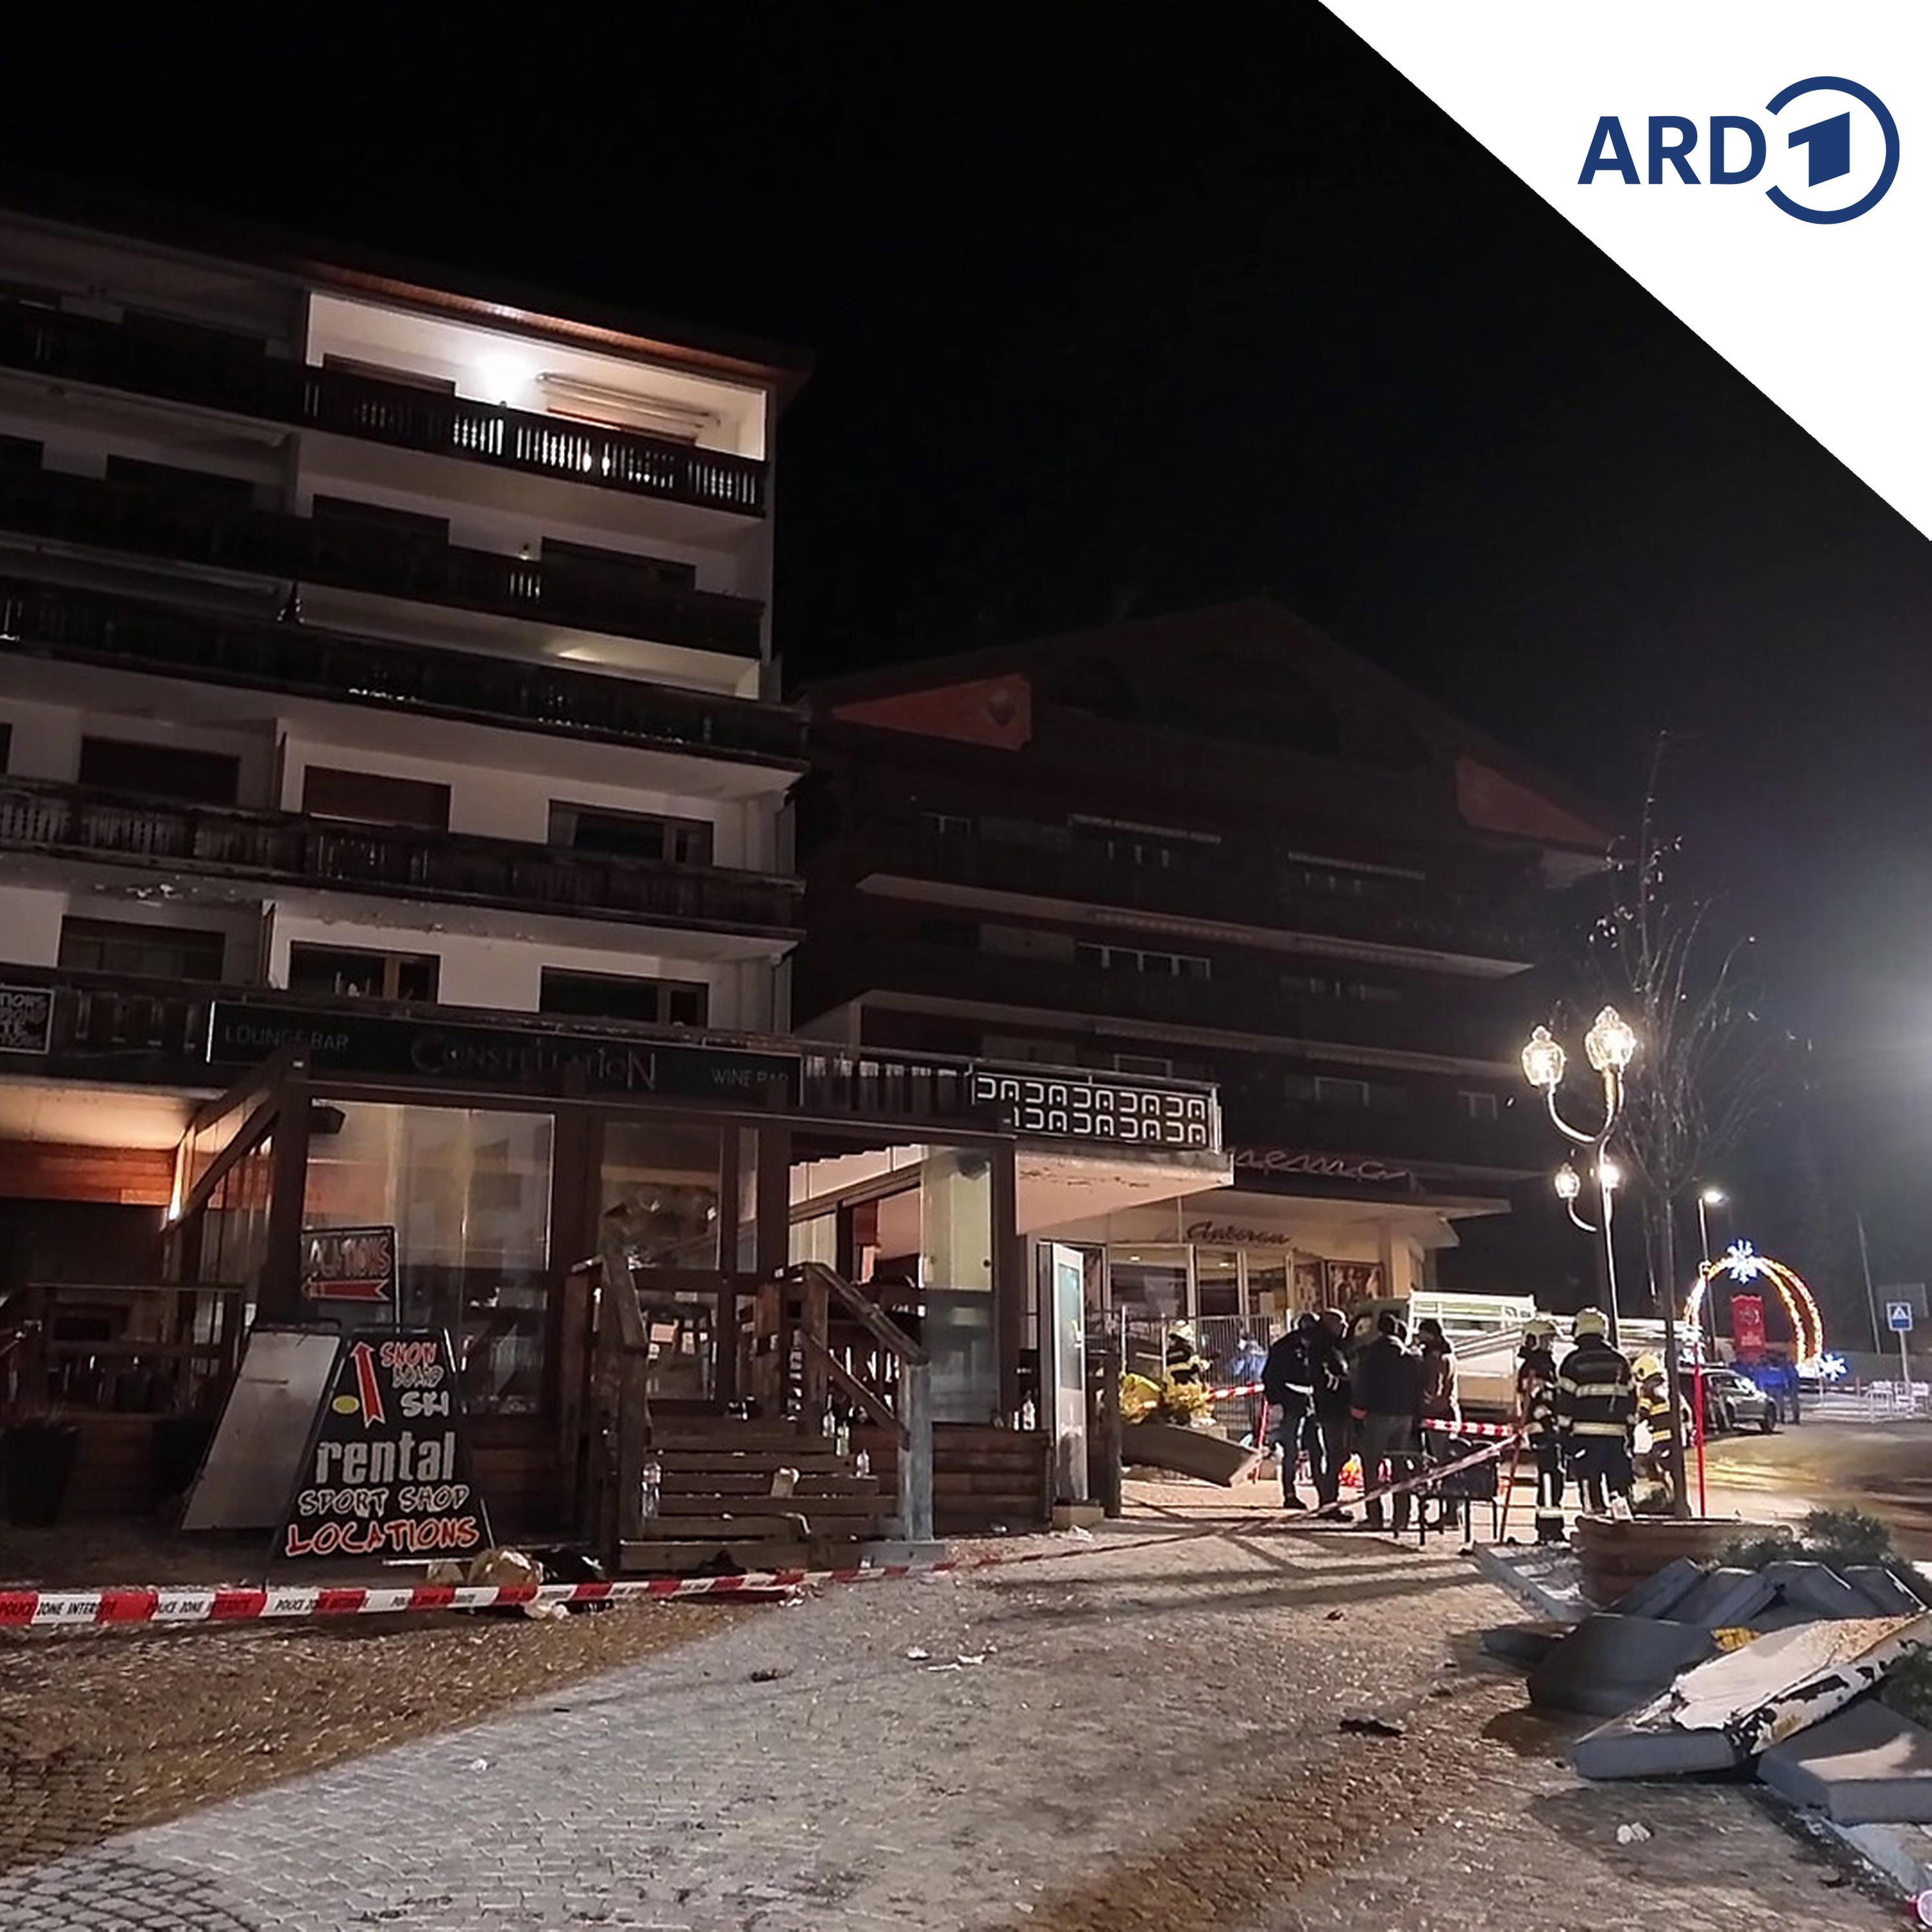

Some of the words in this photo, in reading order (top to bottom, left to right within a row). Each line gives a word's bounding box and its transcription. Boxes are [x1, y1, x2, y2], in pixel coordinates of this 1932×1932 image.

[310, 1030, 350, 1052] BAR
[710, 1066, 753, 1087] WINE
[379, 1340, 438, 1368] SNOW
[400, 1390, 450, 1417] SKI
[315, 1430, 455, 1484] rental
[298, 1488, 389, 1518] SPORT
[397, 1484, 470, 1513] SHOP
[285, 1516, 480, 1557] LOCATIONS
[37, 1601, 64, 1615] ZONE
